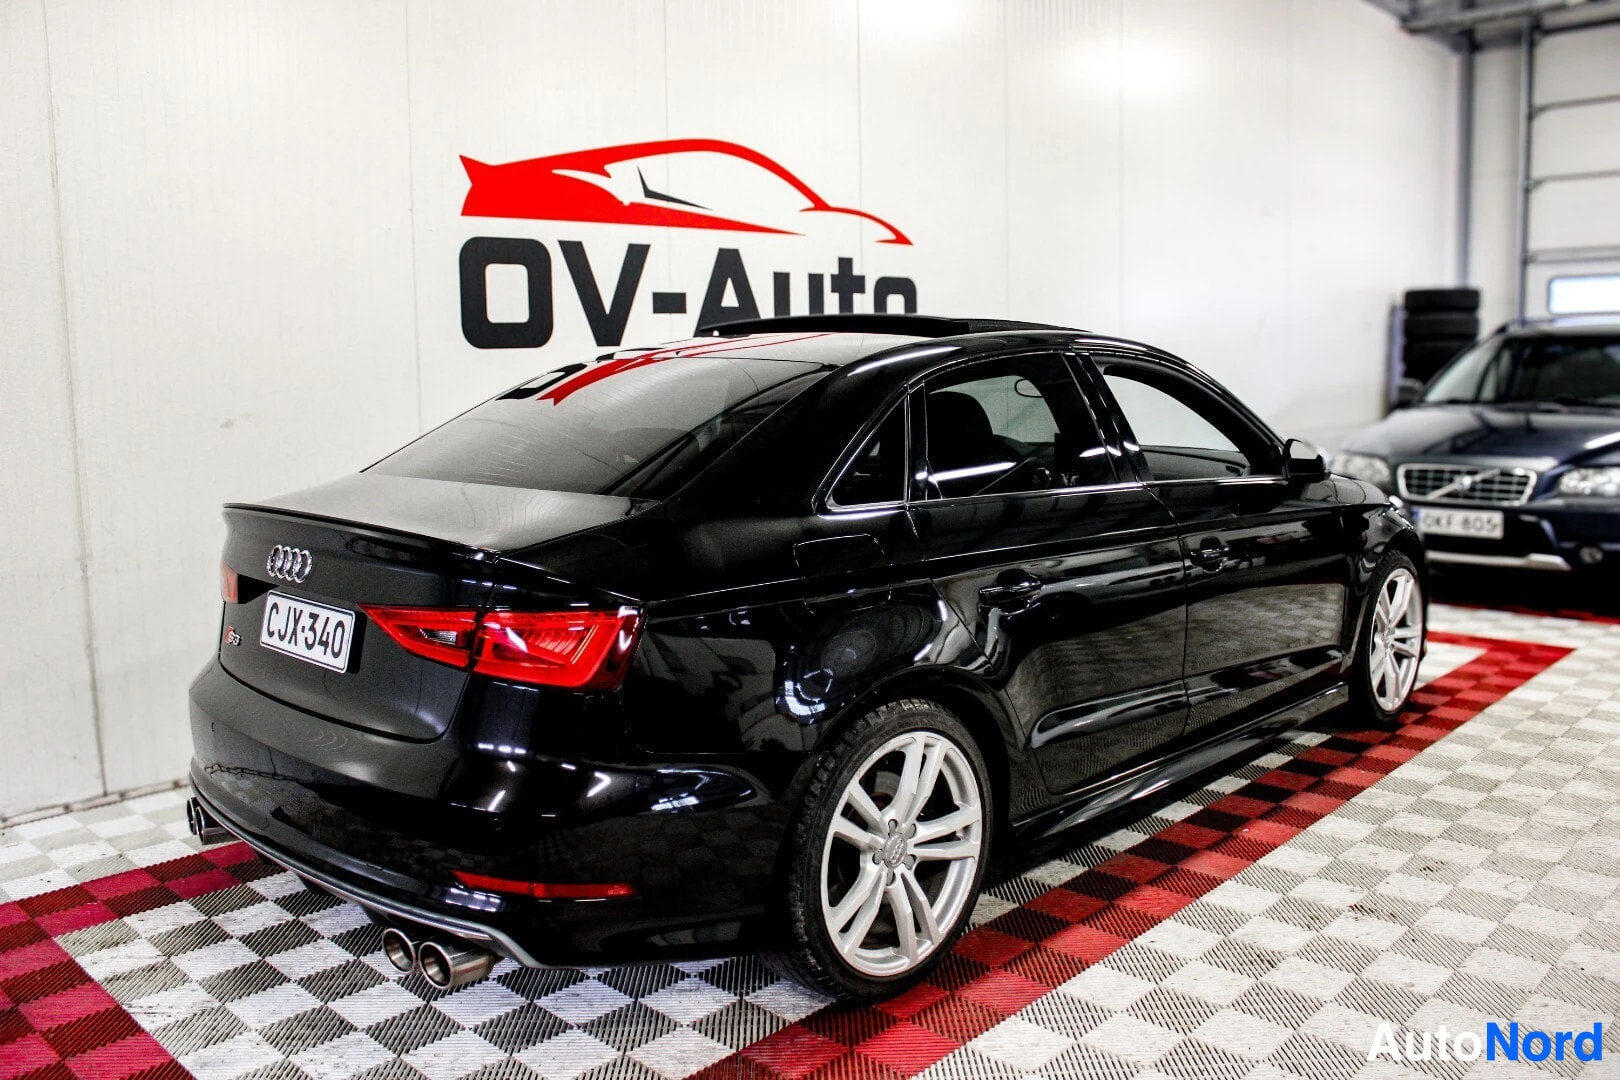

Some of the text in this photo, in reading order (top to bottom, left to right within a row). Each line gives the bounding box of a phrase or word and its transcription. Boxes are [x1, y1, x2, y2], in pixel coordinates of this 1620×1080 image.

[459, 236, 917, 348] OV-Auto
[227, 629, 242, 646] S3
[266, 602, 345, 659] CJX-340
